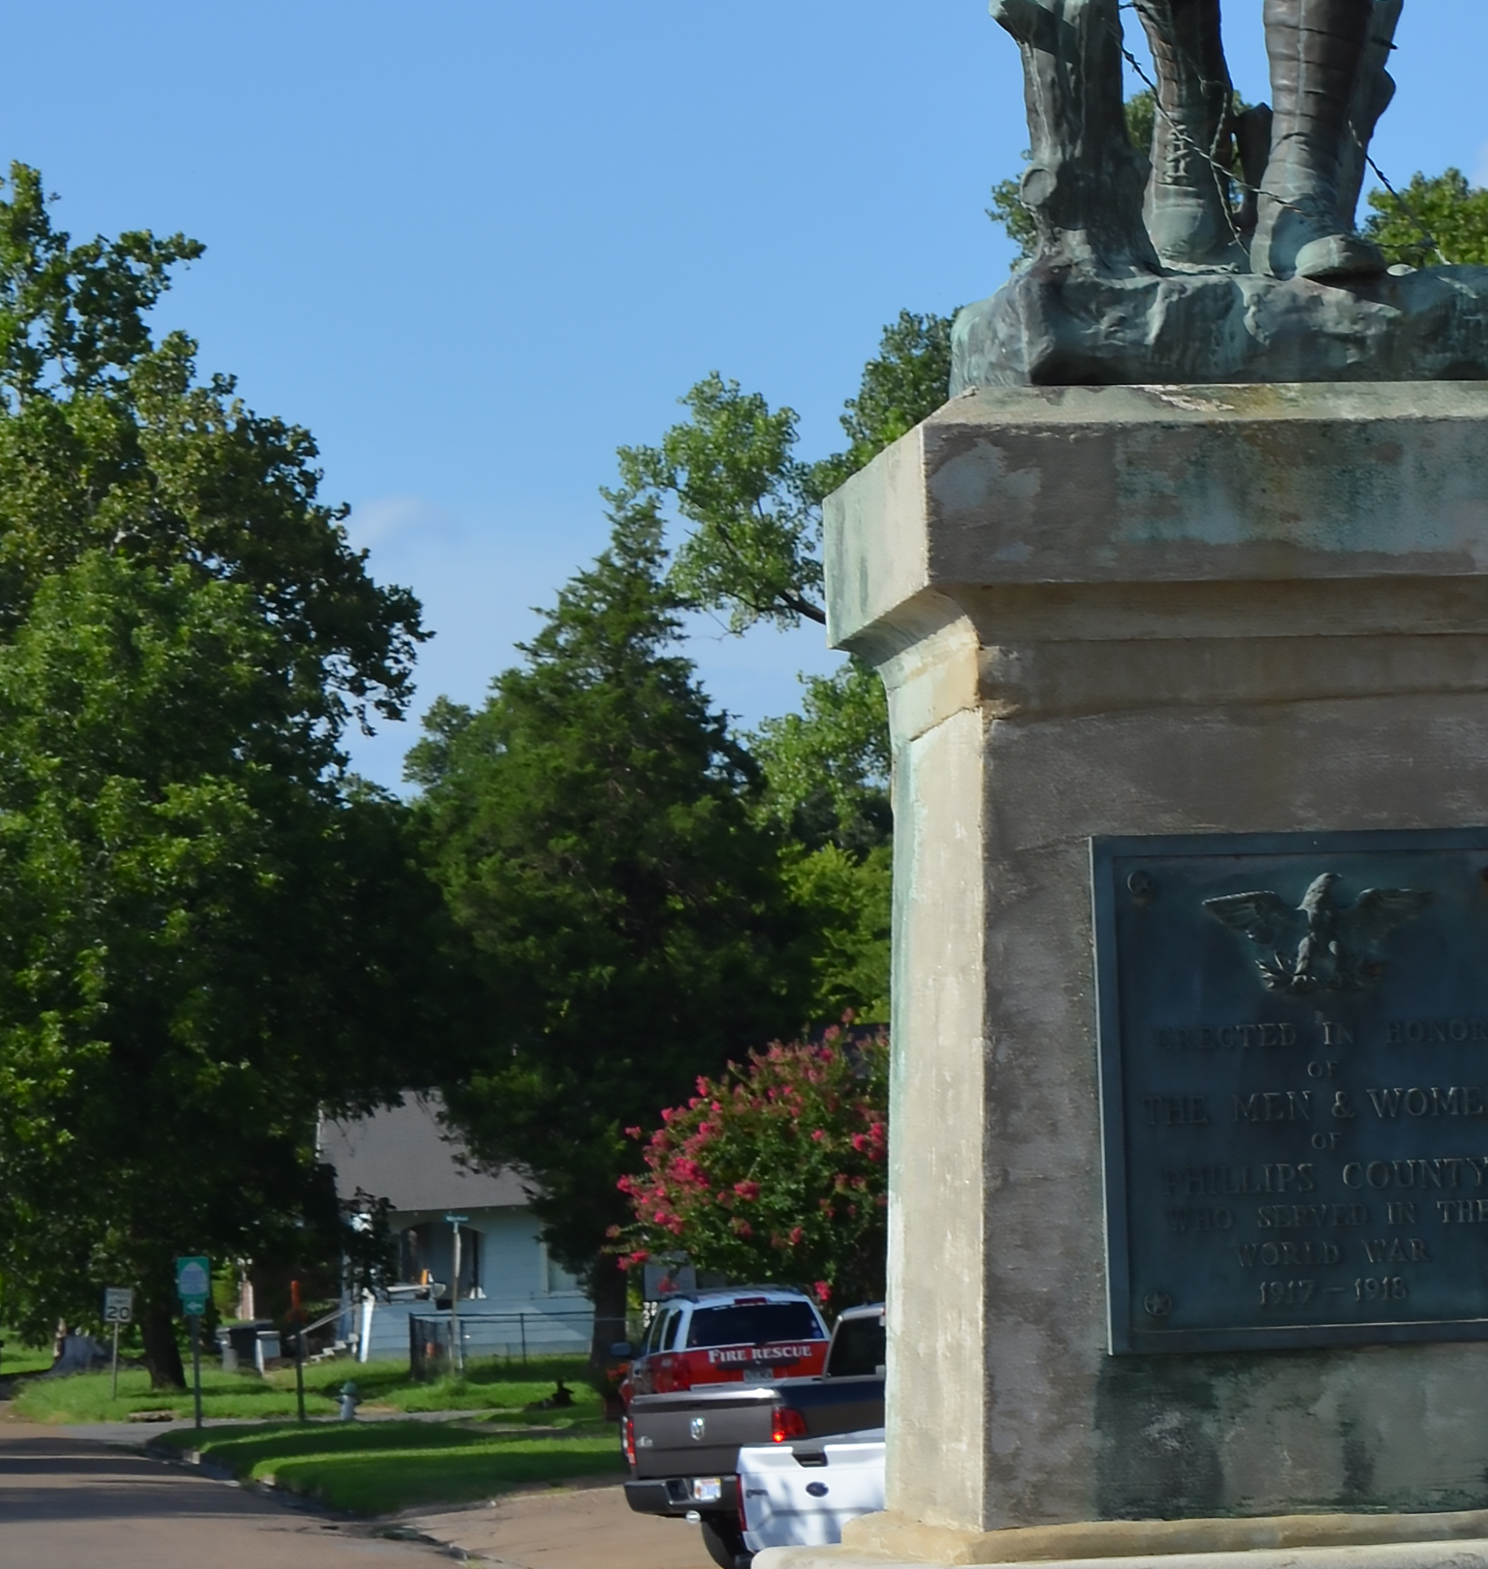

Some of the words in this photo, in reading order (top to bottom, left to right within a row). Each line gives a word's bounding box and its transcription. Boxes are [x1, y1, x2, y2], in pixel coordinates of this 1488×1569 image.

[1158, 1021, 1297, 1050] ERECTED
[1322, 1021, 1355, 1046] IN
[1307, 1060, 1340, 1079] OF
[1141, 1095, 1210, 1125] THE
[1232, 1090, 1311, 1123] MEN
[1331, 1091, 1357, 1119] &
[1311, 1132, 1343, 1151] OF
[1161, 1163, 1316, 1197] PHILLIPS
[1166, 1207, 1234, 1233] WHO
[1257, 1203, 1369, 1229] SERVED
[1386, 1202, 1416, 1225] IN
[1233, 1242, 1343, 1268] WORLD
[1363, 1238, 1432, 1263] WAR
[1259, 1280, 1315, 1305] 1917
[1353, 1277, 1408, 1302] 1918
[107, 1305, 130, 1320] 20
[708, 1348, 747, 1363] FIRE
[752, 1345, 812, 1360] RESCUE
